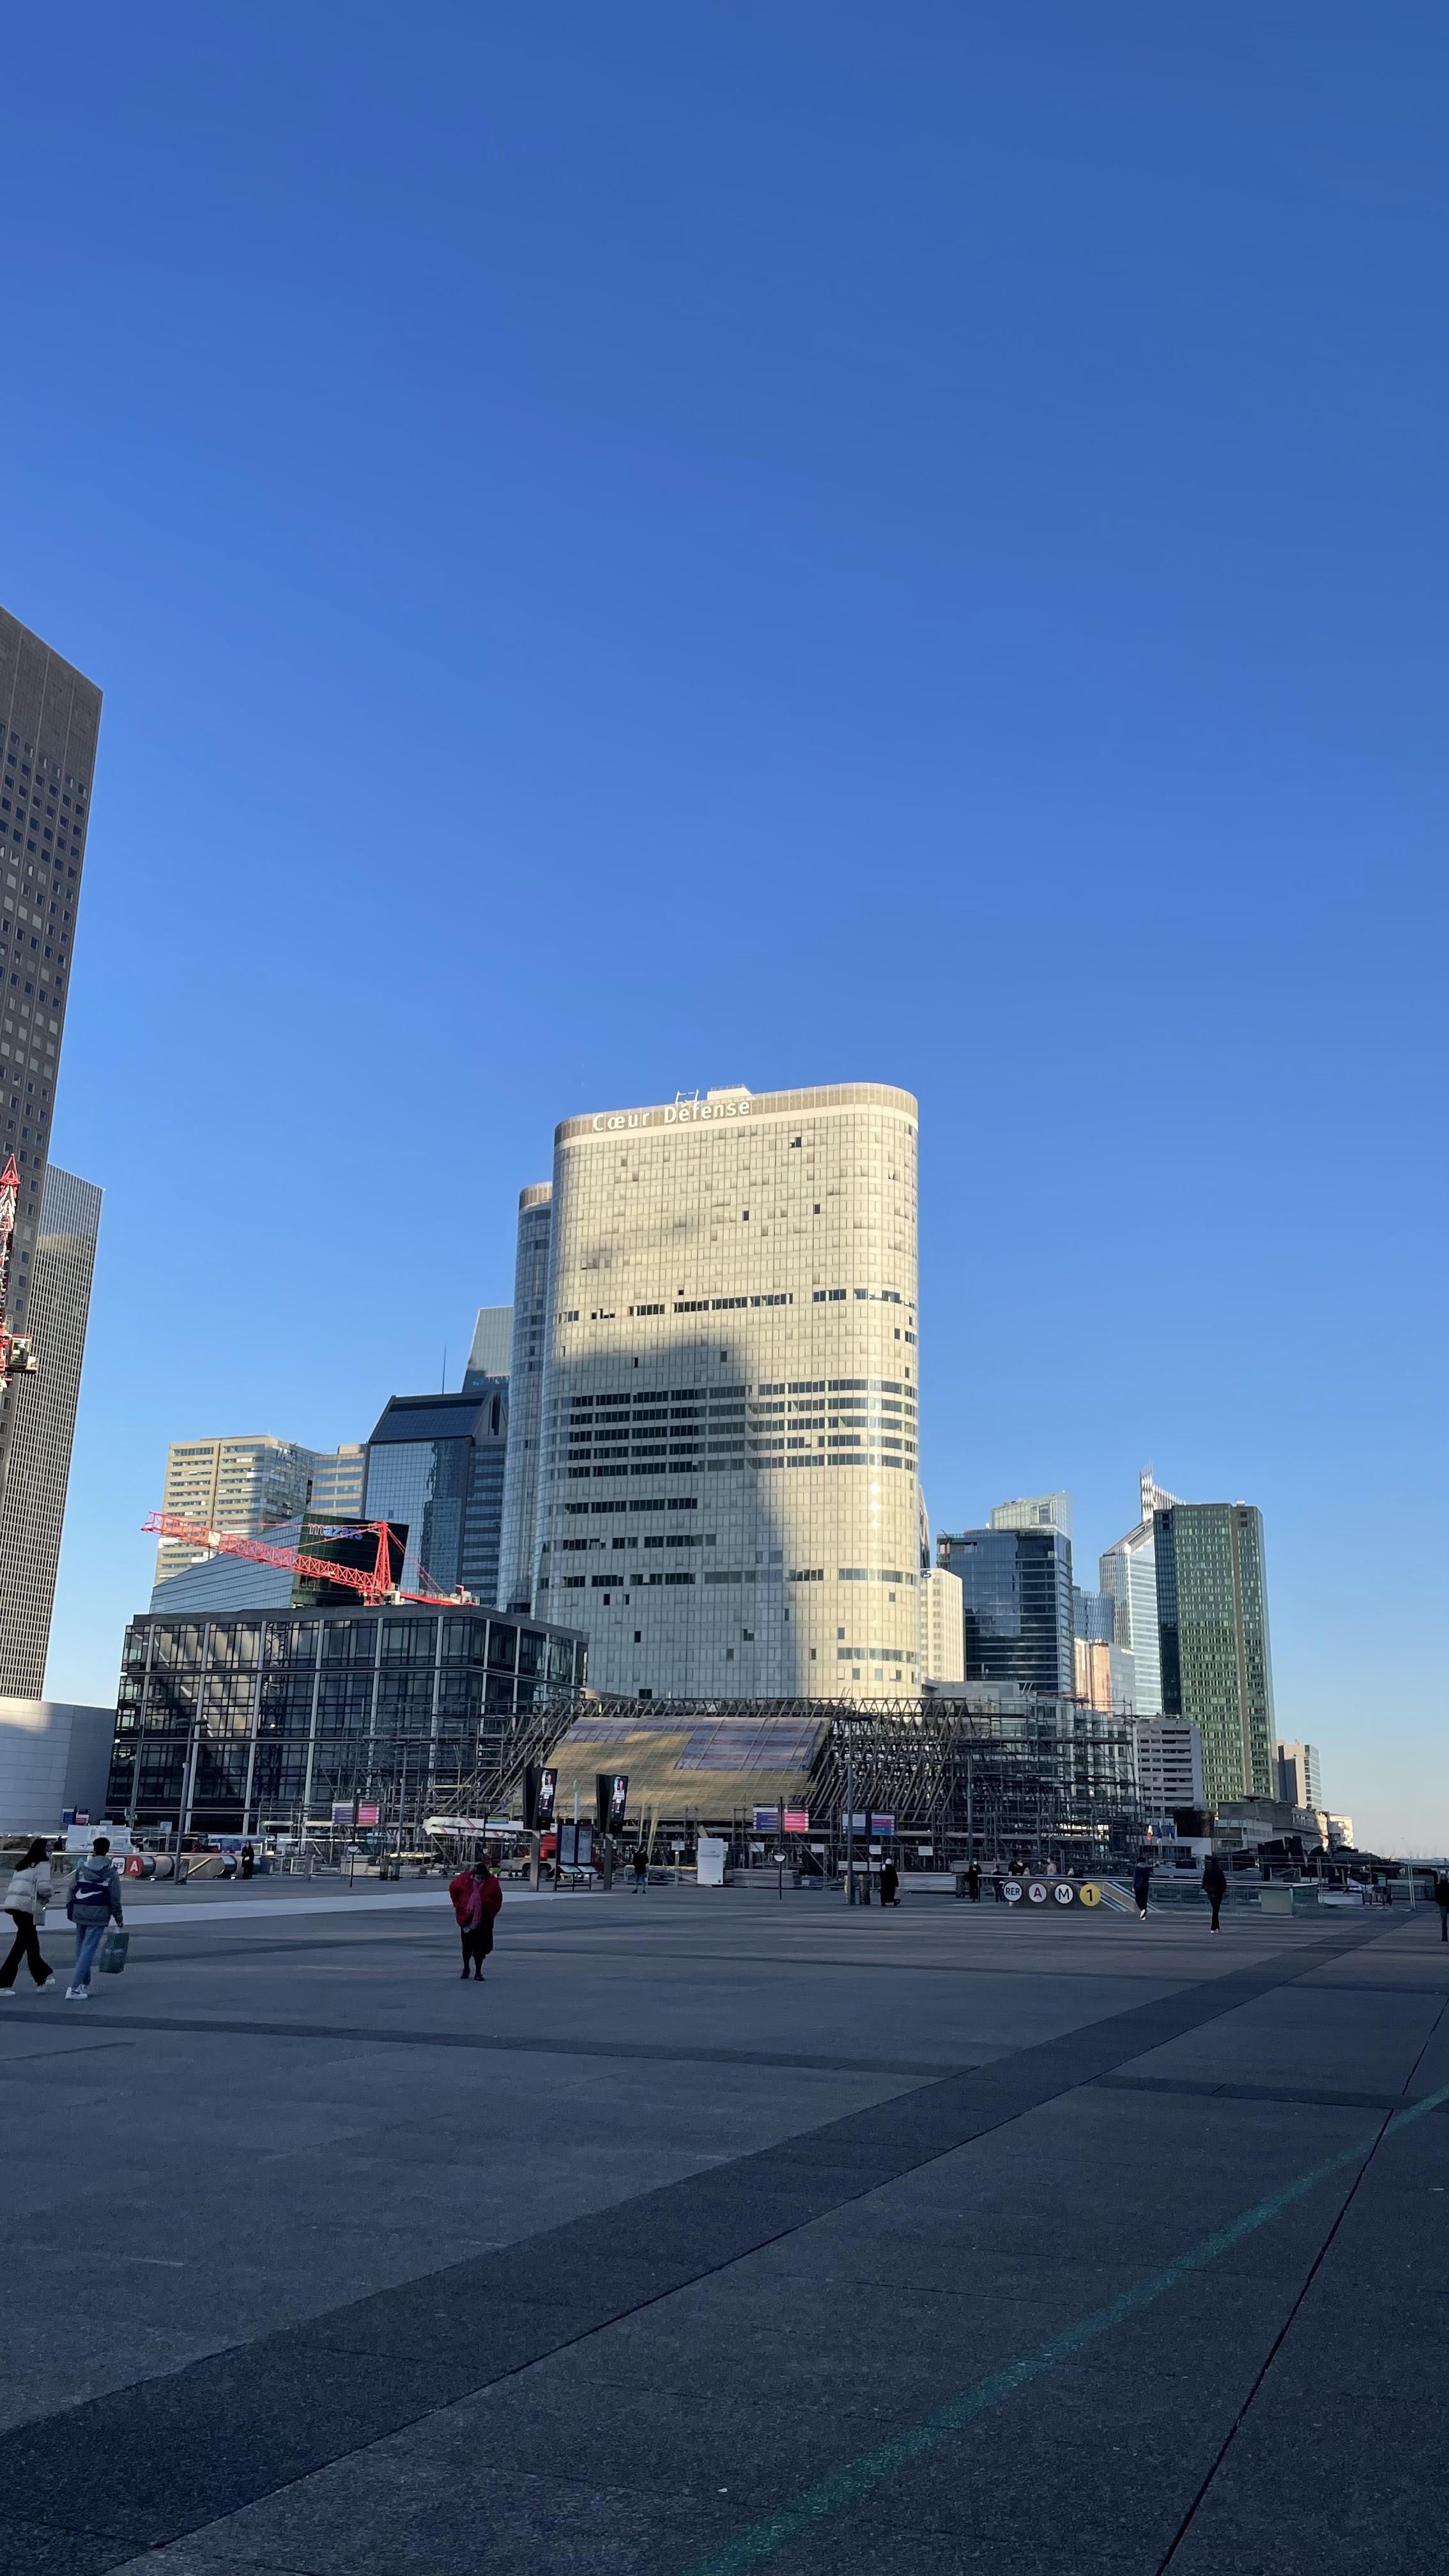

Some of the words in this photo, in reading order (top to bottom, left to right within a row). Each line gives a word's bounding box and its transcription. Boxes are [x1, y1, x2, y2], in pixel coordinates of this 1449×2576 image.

[593, 1112, 649, 1131] Cœur
[664, 1101, 750, 1124] Défense
[309, 1523, 363, 1540] mazars
[130, 1860, 138, 1872] A
[1006, 1887, 1020, 1896] RER
[1033, 1887, 1043, 1898] A
[1058, 1888, 1070, 1900] M
[1086, 1889, 1093, 1902] 1
